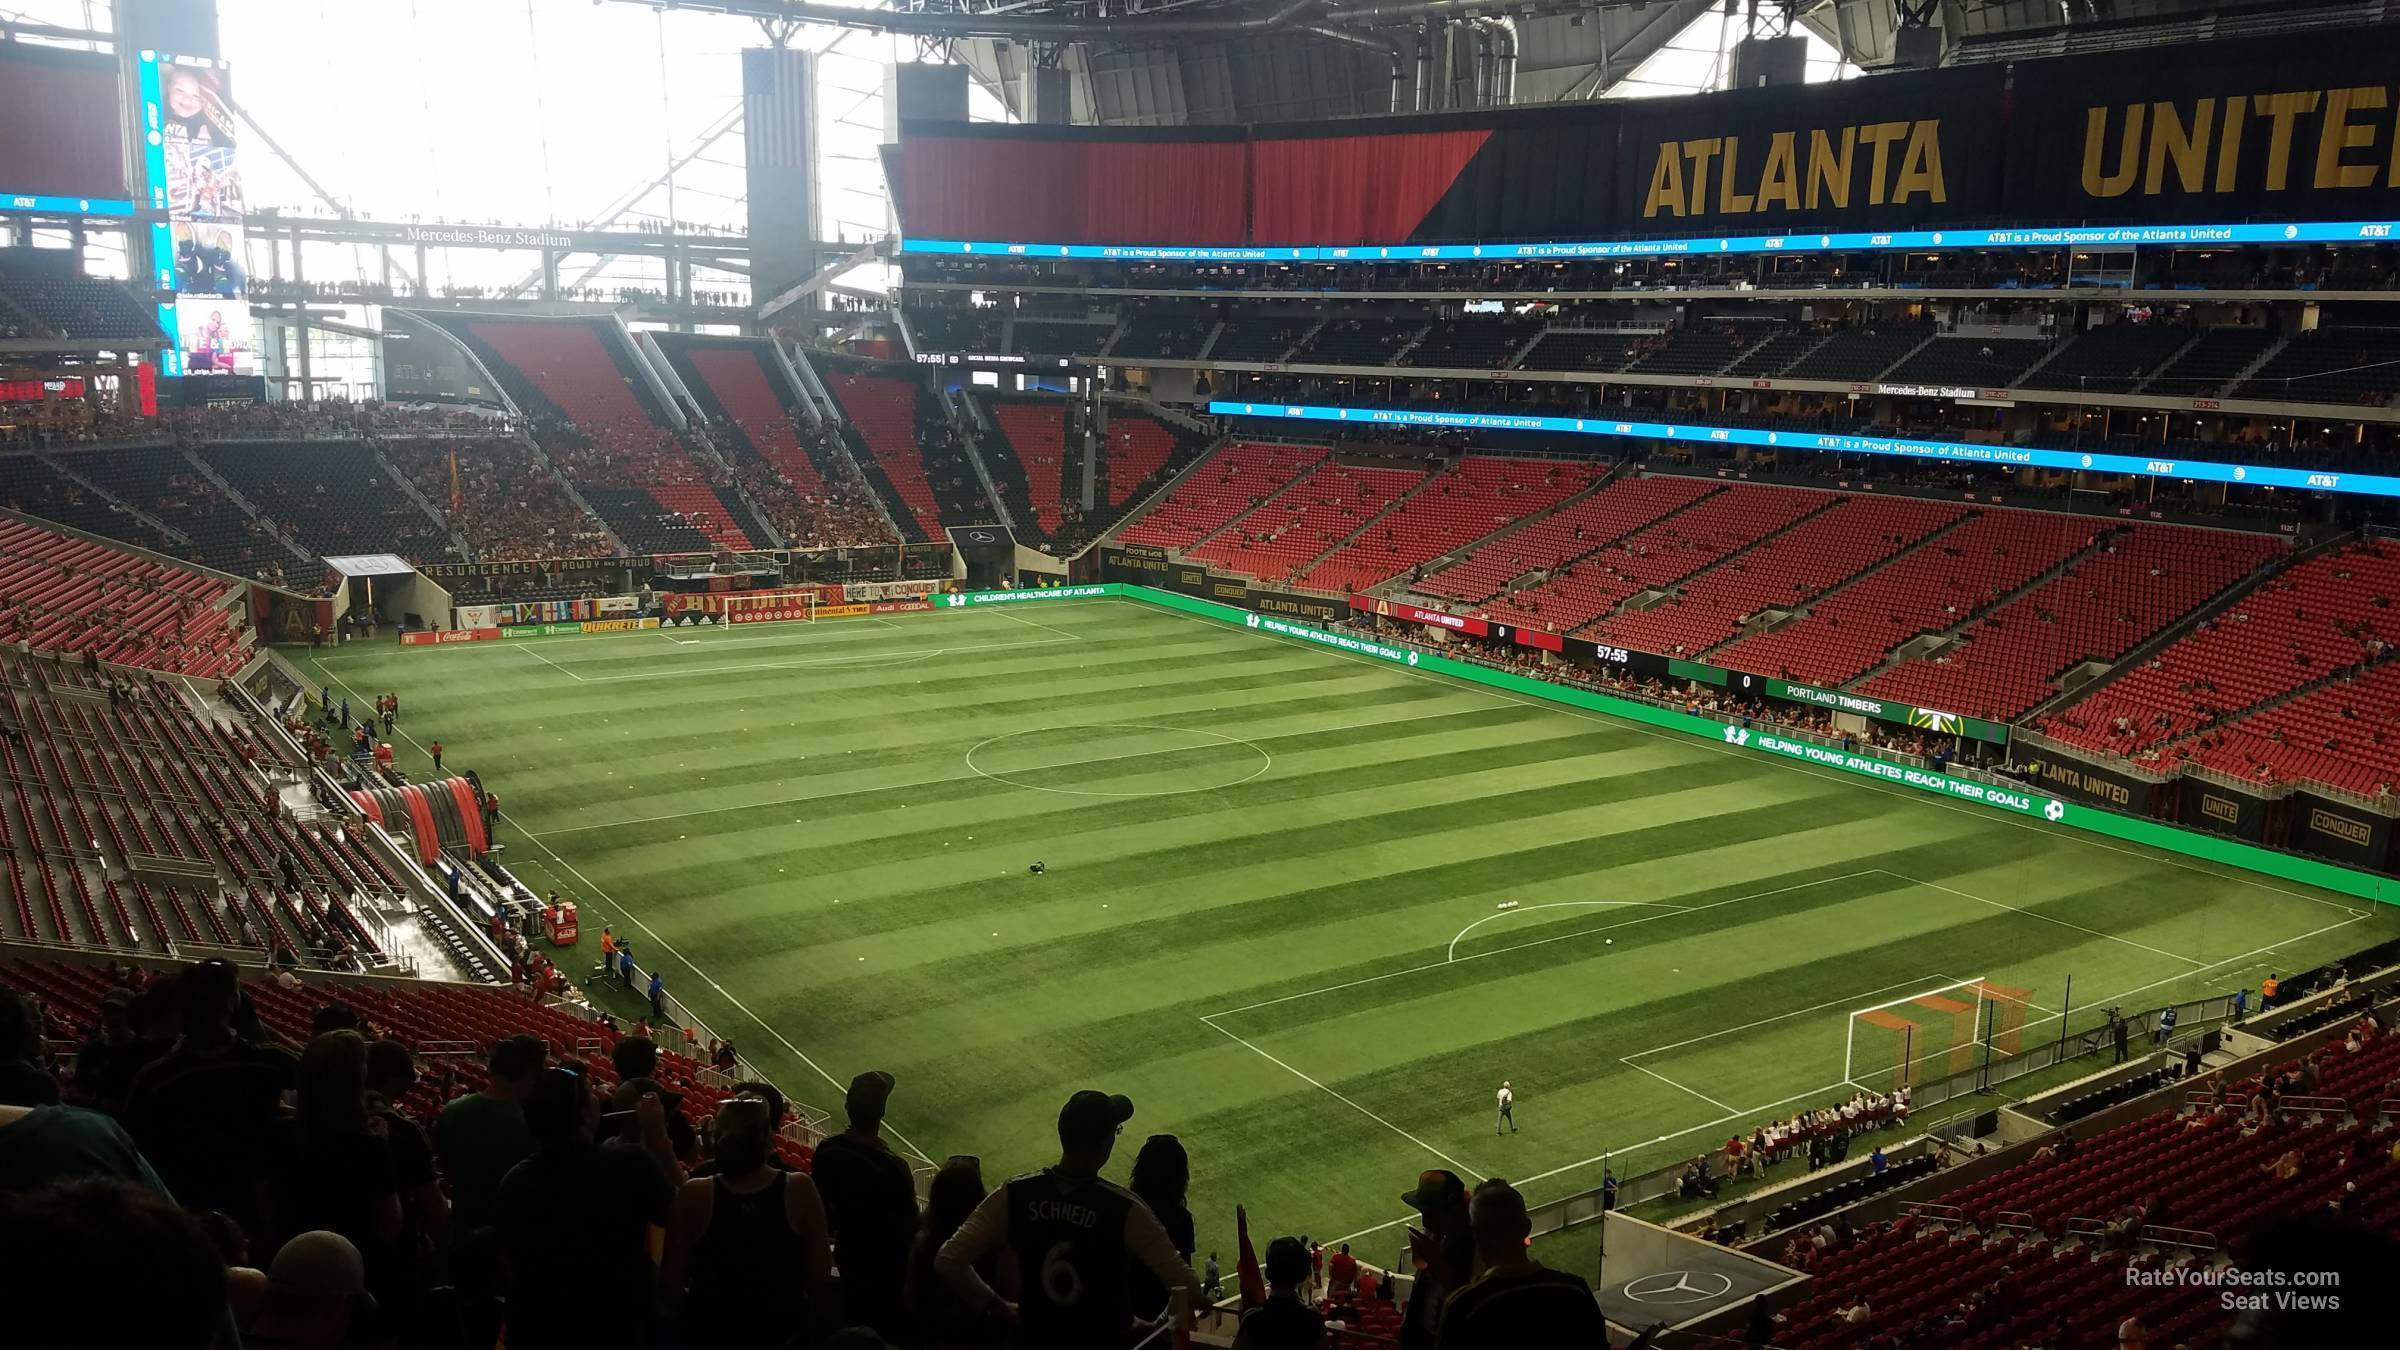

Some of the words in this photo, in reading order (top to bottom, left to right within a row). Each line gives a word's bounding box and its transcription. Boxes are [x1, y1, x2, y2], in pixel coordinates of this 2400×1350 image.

[1643, 119, 1948, 218] ATLANTA
[2081, 86, 2400, 197] UNITE
[13, 197, 36, 208] AT&T
[407, 227, 511, 244] Mercedes-Benz
[515, 232, 572, 247] Stadium
[1987, 233, 2012, 242] AT&T
[2014, 233, 2022, 242] is
[2032, 232, 2061, 241] Proud
[2064, 232, 2105, 243] Sponsor
[2108, 230, 2121, 241] of
[2121, 230, 2140, 240] the
[2143, 229, 2186, 240] Atlanta
[2190, 228, 2232, 239] United
[2359, 225, 2392, 237] AT&T
[1765, 239, 1784, 248] AT&T
[1870, 236, 1892, 245] AT&T
[1136, 249, 1156, 257] Proud
[1157, 250, 1186, 259] Sponsor
[1212, 250, 1241, 258] Atlanta
[1243, 250, 1265, 258] United
[1518, 247, 1537, 255] AT&T
[1553, 246, 1576, 254] Proud
[1577, 245, 1610, 255] Sponsor
[1613, 245, 1621, 253] of
[1621, 245, 1632, 253] the
[1633, 244, 1660, 252] Atlanta
[1663, 243, 1687, 252] United
[916, 354, 942, 363] 57:55
[1878, 384, 1938, 397] Mercedes-Benz
[1940, 387, 1975, 398] Stadium
[1373, 412, 1393, 421] AT&T
[1409, 414, 1432, 423] Proud
[1434, 414, 1467, 426] Sponsor
[1469, 416, 1479, 425] of
[1481, 417, 1511, 426] Atlanta
[1514, 418, 1541, 427] United
[1817, 437, 1840, 447] AT&T
[1843, 438, 1850, 448] is
[1862, 440, 1891, 451] Proud
[1894, 442, 1934, 455] Sponsor
[1938, 444, 1950, 455] of
[1952, 446, 1991, 459] Atlanta
[1994, 449, 2030, 461] United
[2146, 461, 2175, 474] AT&T
[2306, 474, 2340, 487] AT&T
[425, 565, 530, 576] RESURGENCE
[619, 558, 650, 568] PROUD
[1108, 556, 1141, 570] ATLANTA
[1183, 573, 1200, 583] UNITE
[846, 585, 867, 598] HERE
[870, 585, 880, 596] TO
[894, 582, 936, 596] CONQUER
[974, 593, 1016, 603] CHILDREN'S
[1016, 591, 1062, 601] HEALTHCARE
[1074, 587, 1105, 596] ATLANTA
[1216, 586, 1245, 597] CONQUER
[876, 604, 895, 612] Audi
[1259, 599, 1298, 613] ATLANTA
[1301, 603, 1335, 618] UNITED
[1414, 610, 1440, 624] ATLANTA
[1441, 615, 1464, 628] UNITED
[582, 621, 640, 633] QUIKRETE
[1499, 626, 1505, 637] 0
[1264, 620, 1288, 632] HELPING
[1288, 625, 1309, 637] YOUNG
[1309, 629, 1338, 644] ATHLETES
[1338, 637, 1360, 649] REACH
[1360, 642, 1379, 654] THEIR
[1379, 647, 1401, 660] GOALS
[1597, 645, 1628, 663] 57:55
[1743, 676, 1750, 688] 0
[1787, 685, 1837, 704] PORTLAND
[1838, 695, 1882, 714] TIMBERS
[1758, 735, 1803, 756] HELPING
[1805, 746, 1844, 765] YOUNG
[1846, 757, 1902, 779] ATHLETES
[1904, 771, 1945, 790] REACH
[1948, 781, 1984, 799] THEIR
[1986, 790, 2030, 811] GOALS
[2083, 773, 2129, 805] UNITED
[2205, 798, 2236, 819] UNITE
[2314, 816, 2368, 842] CONQUER
[1029, 1200, 1097, 1228] SCHNEID
[1041, 1241, 1081, 1305] 6
